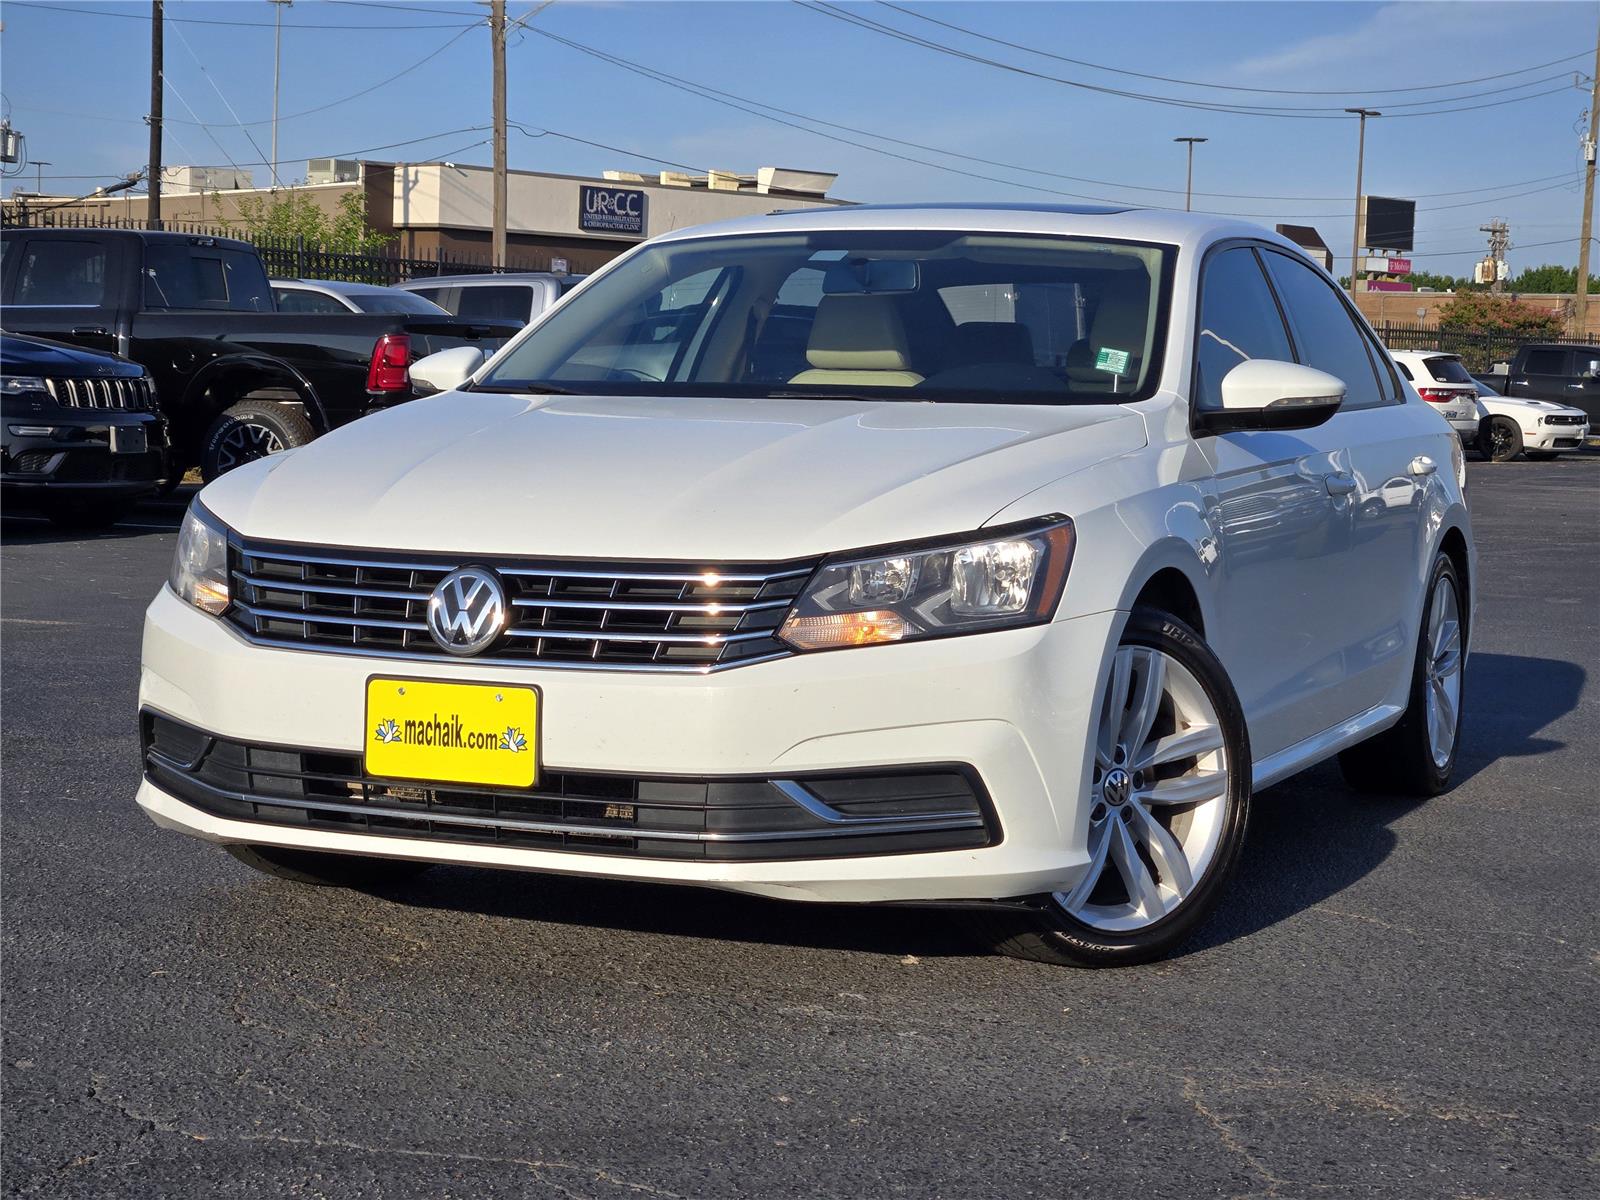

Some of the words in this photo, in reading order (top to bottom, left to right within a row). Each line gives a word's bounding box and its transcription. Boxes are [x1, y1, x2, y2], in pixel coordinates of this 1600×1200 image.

[583, 213, 602, 221] UNITED
[602, 214, 640, 222] REHABILITATION
[404, 713, 498, 751] machaik.com
